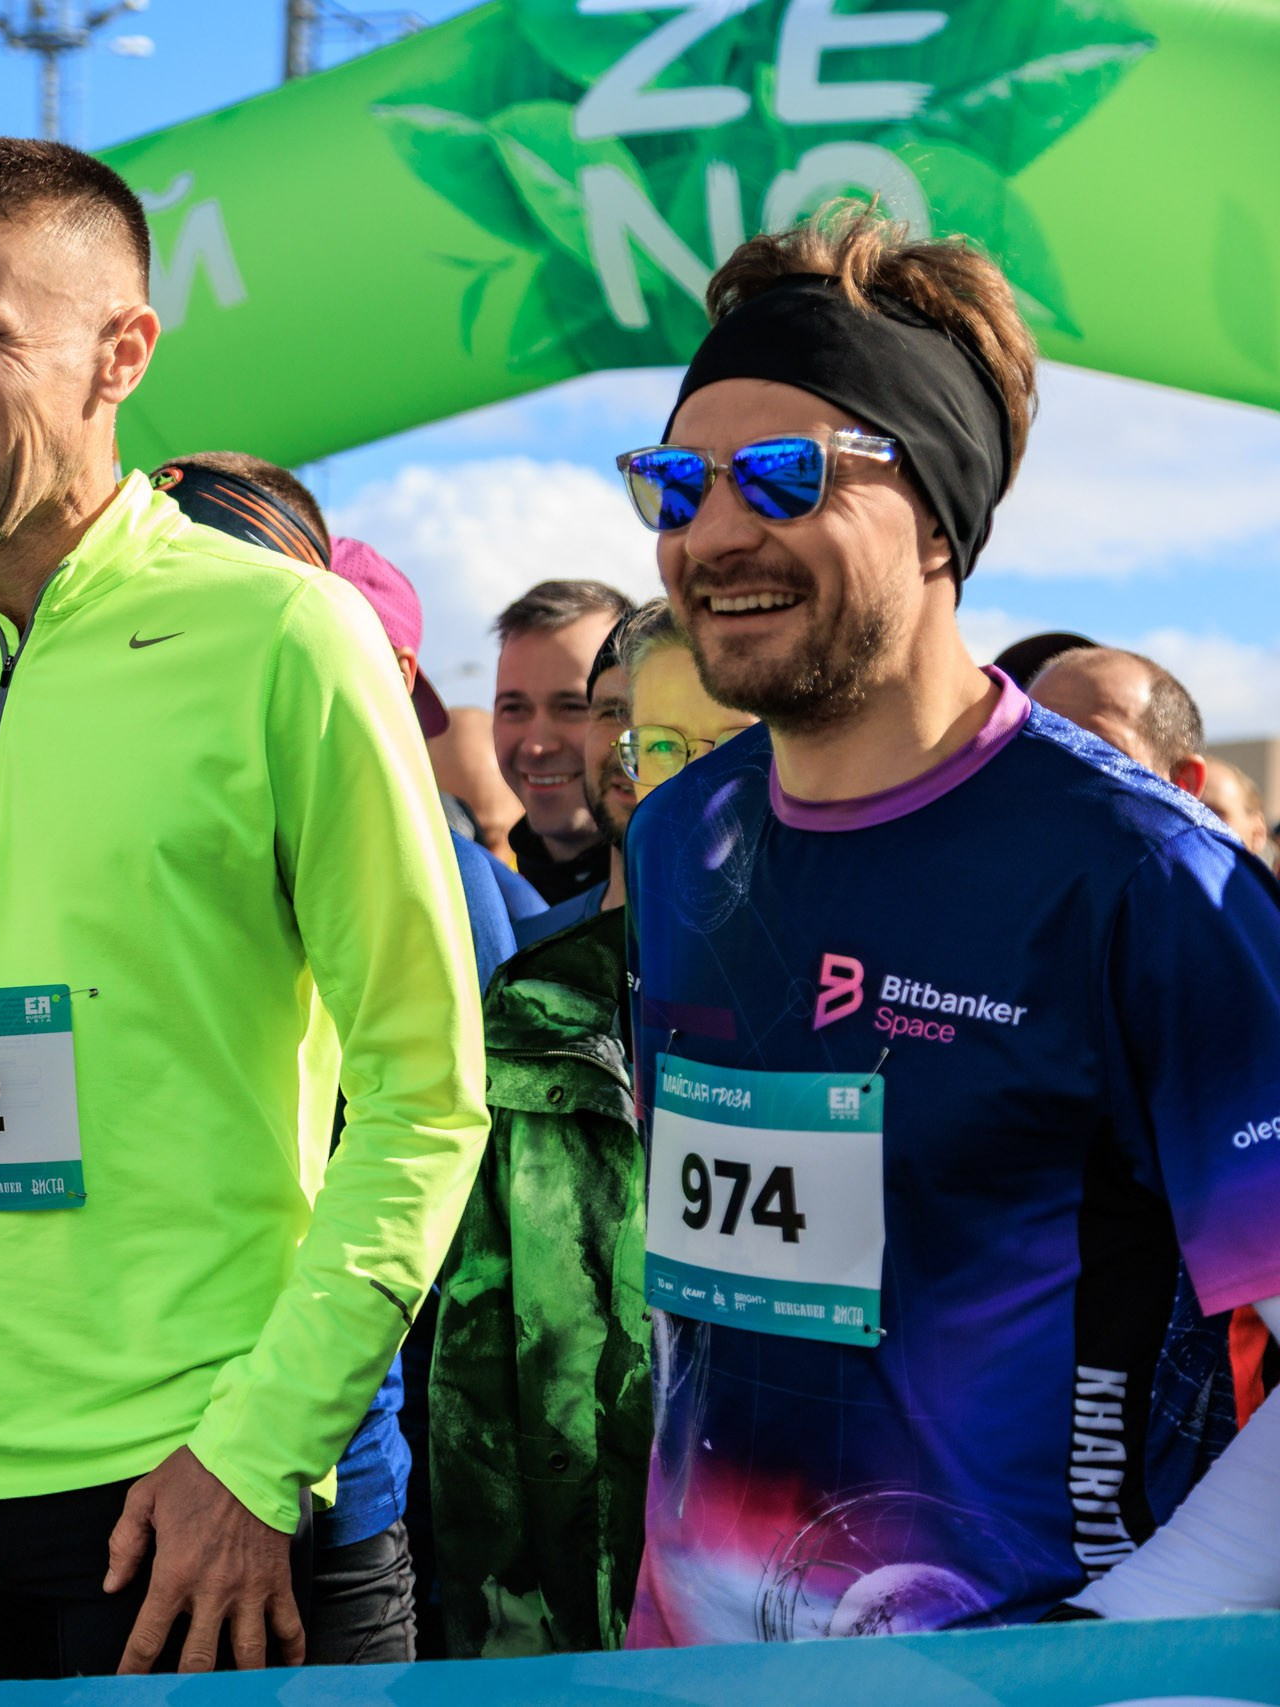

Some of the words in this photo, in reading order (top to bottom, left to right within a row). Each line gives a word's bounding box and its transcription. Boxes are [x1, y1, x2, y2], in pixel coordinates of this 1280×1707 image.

[880, 974, 1028, 1026] Bitbanker
[874, 1006, 956, 1043] Space
[662, 1072, 710, 1104] МАЙСКАЯ
[681, 1152, 807, 1243] 974
[735, 1302, 746, 1312] FIT
[773, 1300, 826, 1319] BERGAUER
[1068, 1364, 1138, 1580] KHARITO
